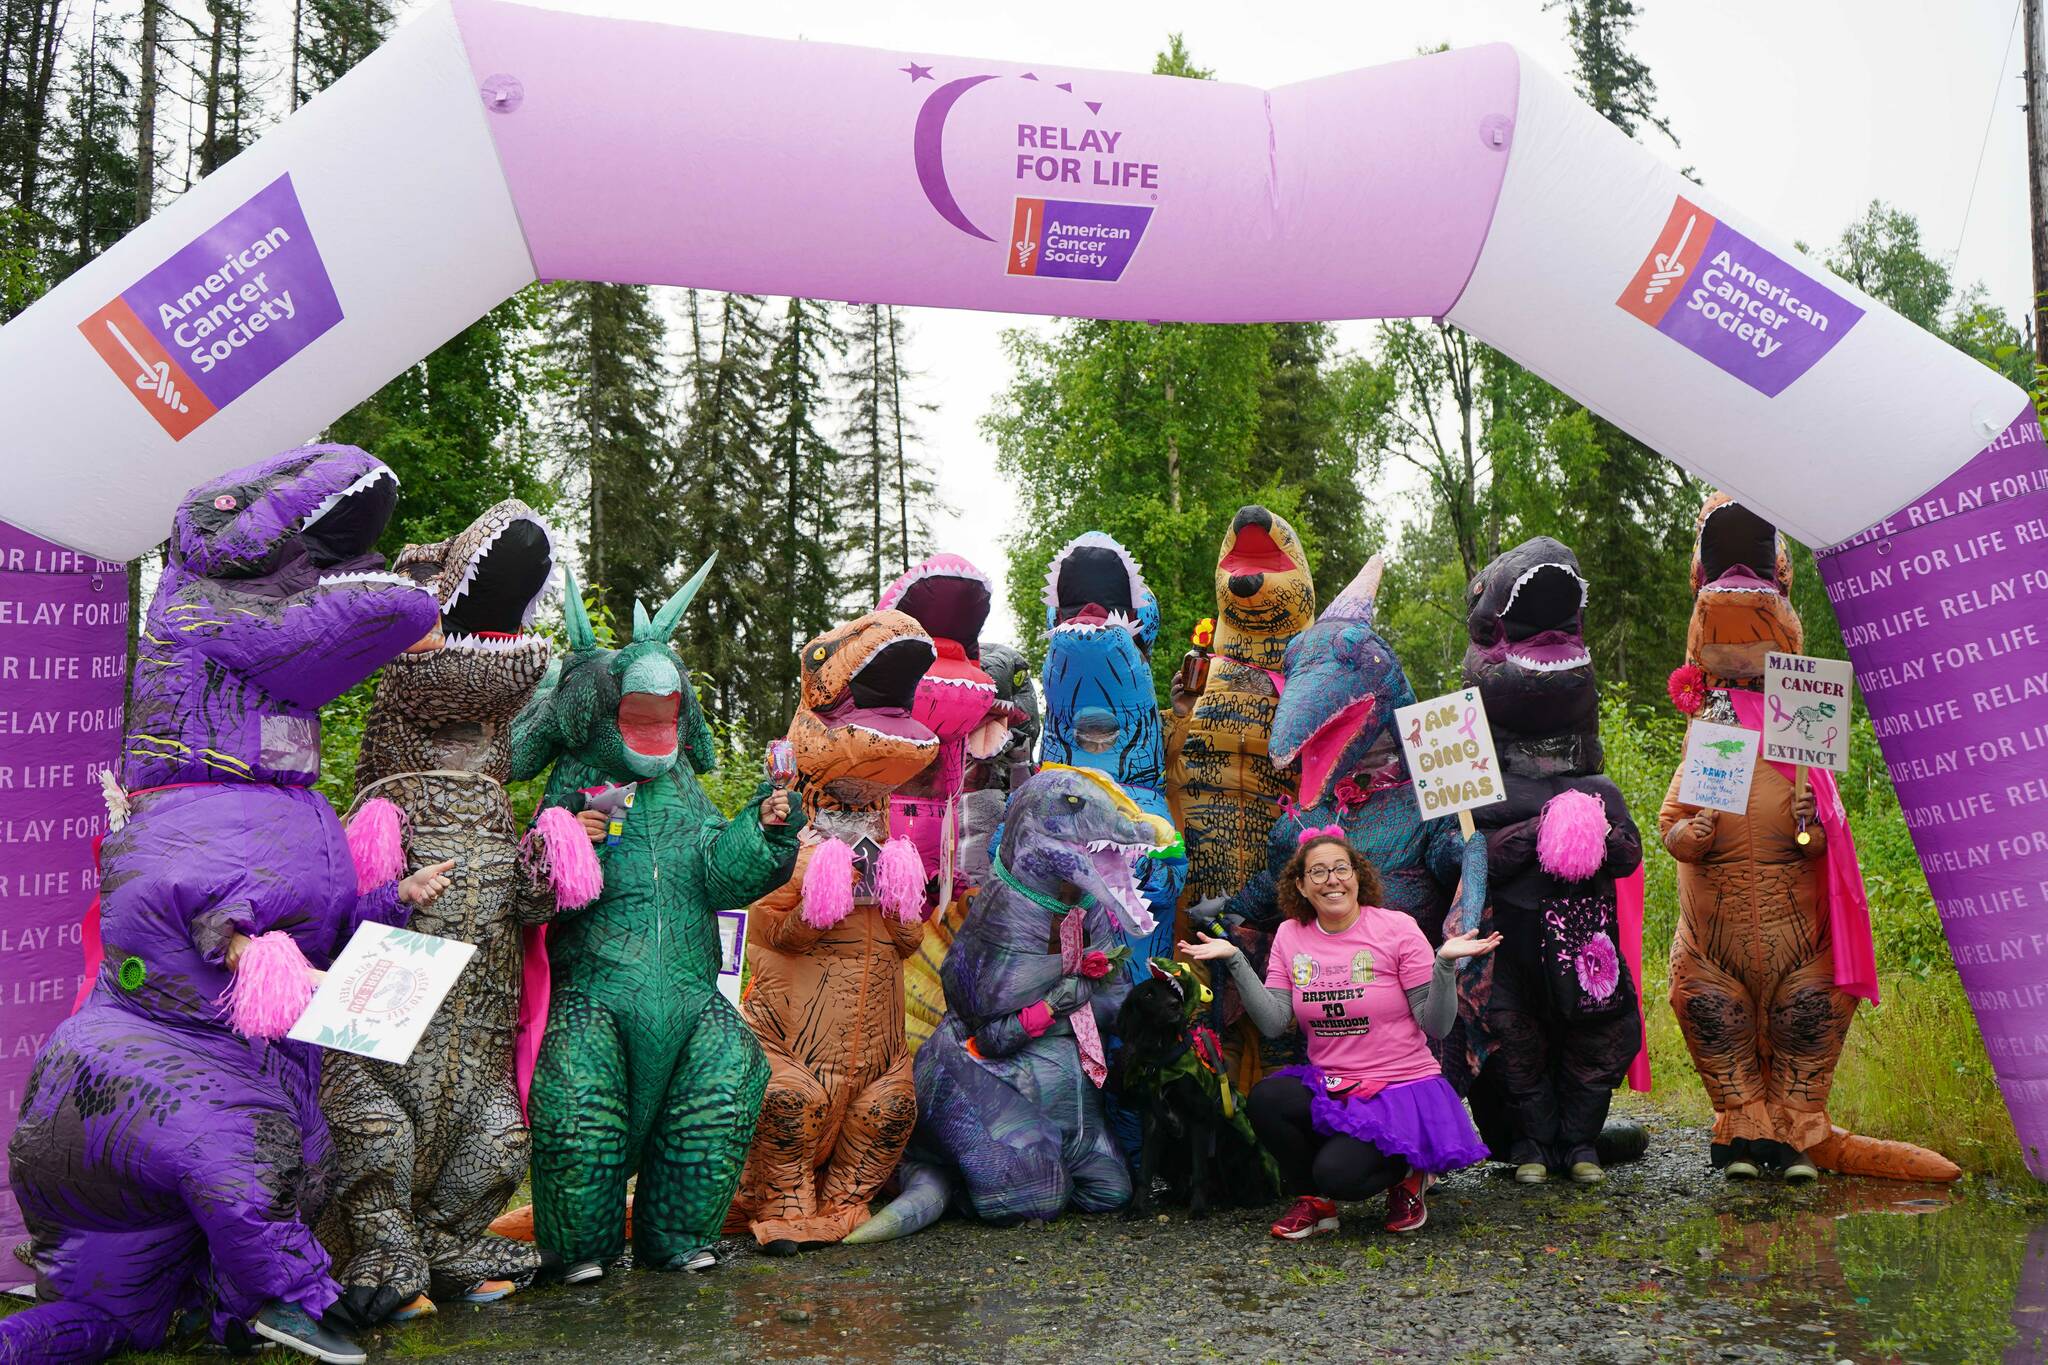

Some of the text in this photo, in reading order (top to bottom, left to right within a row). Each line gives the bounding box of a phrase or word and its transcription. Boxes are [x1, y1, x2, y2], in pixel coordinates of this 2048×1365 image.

[1018, 124, 1122, 153] RELAY
[1017, 154, 1158, 189] FOR LIFE
[1047, 236, 1106, 251] Cancer
[1048, 221, 1130, 239] American
[1045, 250, 1107, 267] Society
[158, 226, 291, 329] American
[1711, 250, 1829, 332] American
[174, 272, 267, 348] Cancer
[1702, 269, 1789, 330] Cancer
[190, 290, 296, 373] Society
[1686, 288, 1783, 358] Society
[1908, 486, 1983, 527] RELAY
[1990, 474, 2031, 502] FOR
[0, 549, 24, 571] R
[35, 551, 84, 573] LIFE
[1847, 565, 1892, 598] ELAY
[1900, 549, 1950, 580] FOR
[1955, 531, 2006, 563] LIFE
[73, 603, 109, 625] FOR
[113, 602, 128, 624] LIF
[1883, 607, 1930, 637] LIFE
[1940, 578, 2016, 620] RELAY
[29, 657, 79, 679] LIFE
[92, 654, 127, 678] RELA
[1769, 655, 1816, 674] MAKE
[1878, 658, 1925, 687] ELAY
[1932, 642, 1984, 673] FOR
[1987, 624, 2040, 657] LIFE
[1781, 677, 1845, 697] CANCER
[1914, 699, 1962, 729] LIFE
[1972, 672, 2048, 713] RELAY
[67, 710, 104, 733] FOR
[1425, 705, 1459, 732] AK
[1419, 739, 1480, 772] DINO
[1767, 743, 1838, 766] EXTINCT
[1911, 750, 1958, 780] ELAY
[1965, 737, 2017, 766] FOR
[24, 765, 74, 788] LIFE
[1424, 776, 1494, 810] DIVAS
[1947, 793, 1995, 822] LIFE
[0, 819, 54, 843] LAY
[63, 815, 99, 841] FOR
[1943, 844, 1990, 871] ELAY
[1998, 831, 2048, 861] FOR
[19, 872, 69, 897] LIFE
[1979, 888, 2028, 914] LIFE
[14, 978, 64, 1004] LIFE
[1302, 988, 1365, 1003] BREWERY
[1309, 1016, 1370, 1028] BATHROOM
[1322, 1003, 1346, 1018] TO
